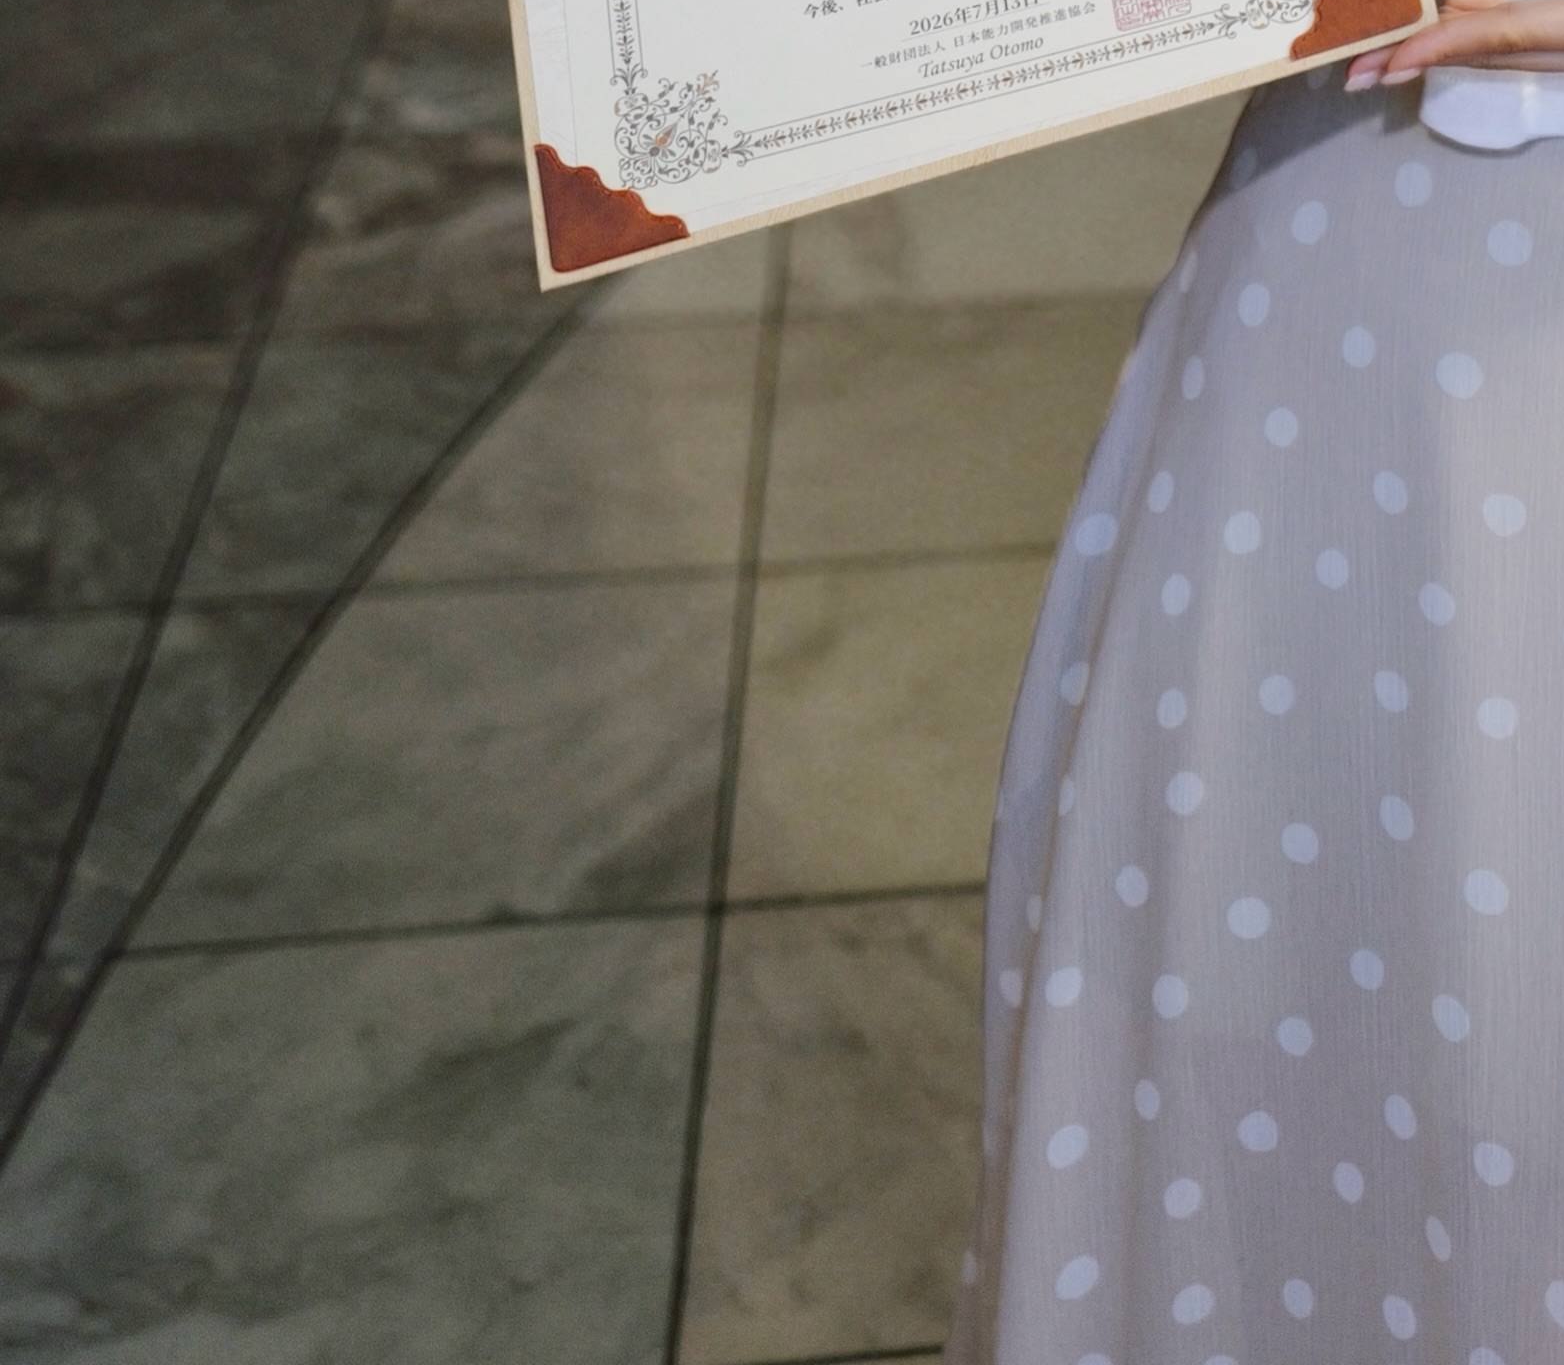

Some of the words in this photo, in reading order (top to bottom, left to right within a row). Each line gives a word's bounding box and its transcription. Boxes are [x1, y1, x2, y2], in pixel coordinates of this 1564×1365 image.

[861, 40, 946, 69] 一般財団法人
[953, 1, 1096, 48] 日本能力開発推進協会
[917, 51, 985, 78] Tatsuya
[989, 37, 1044, 61] Otomo
